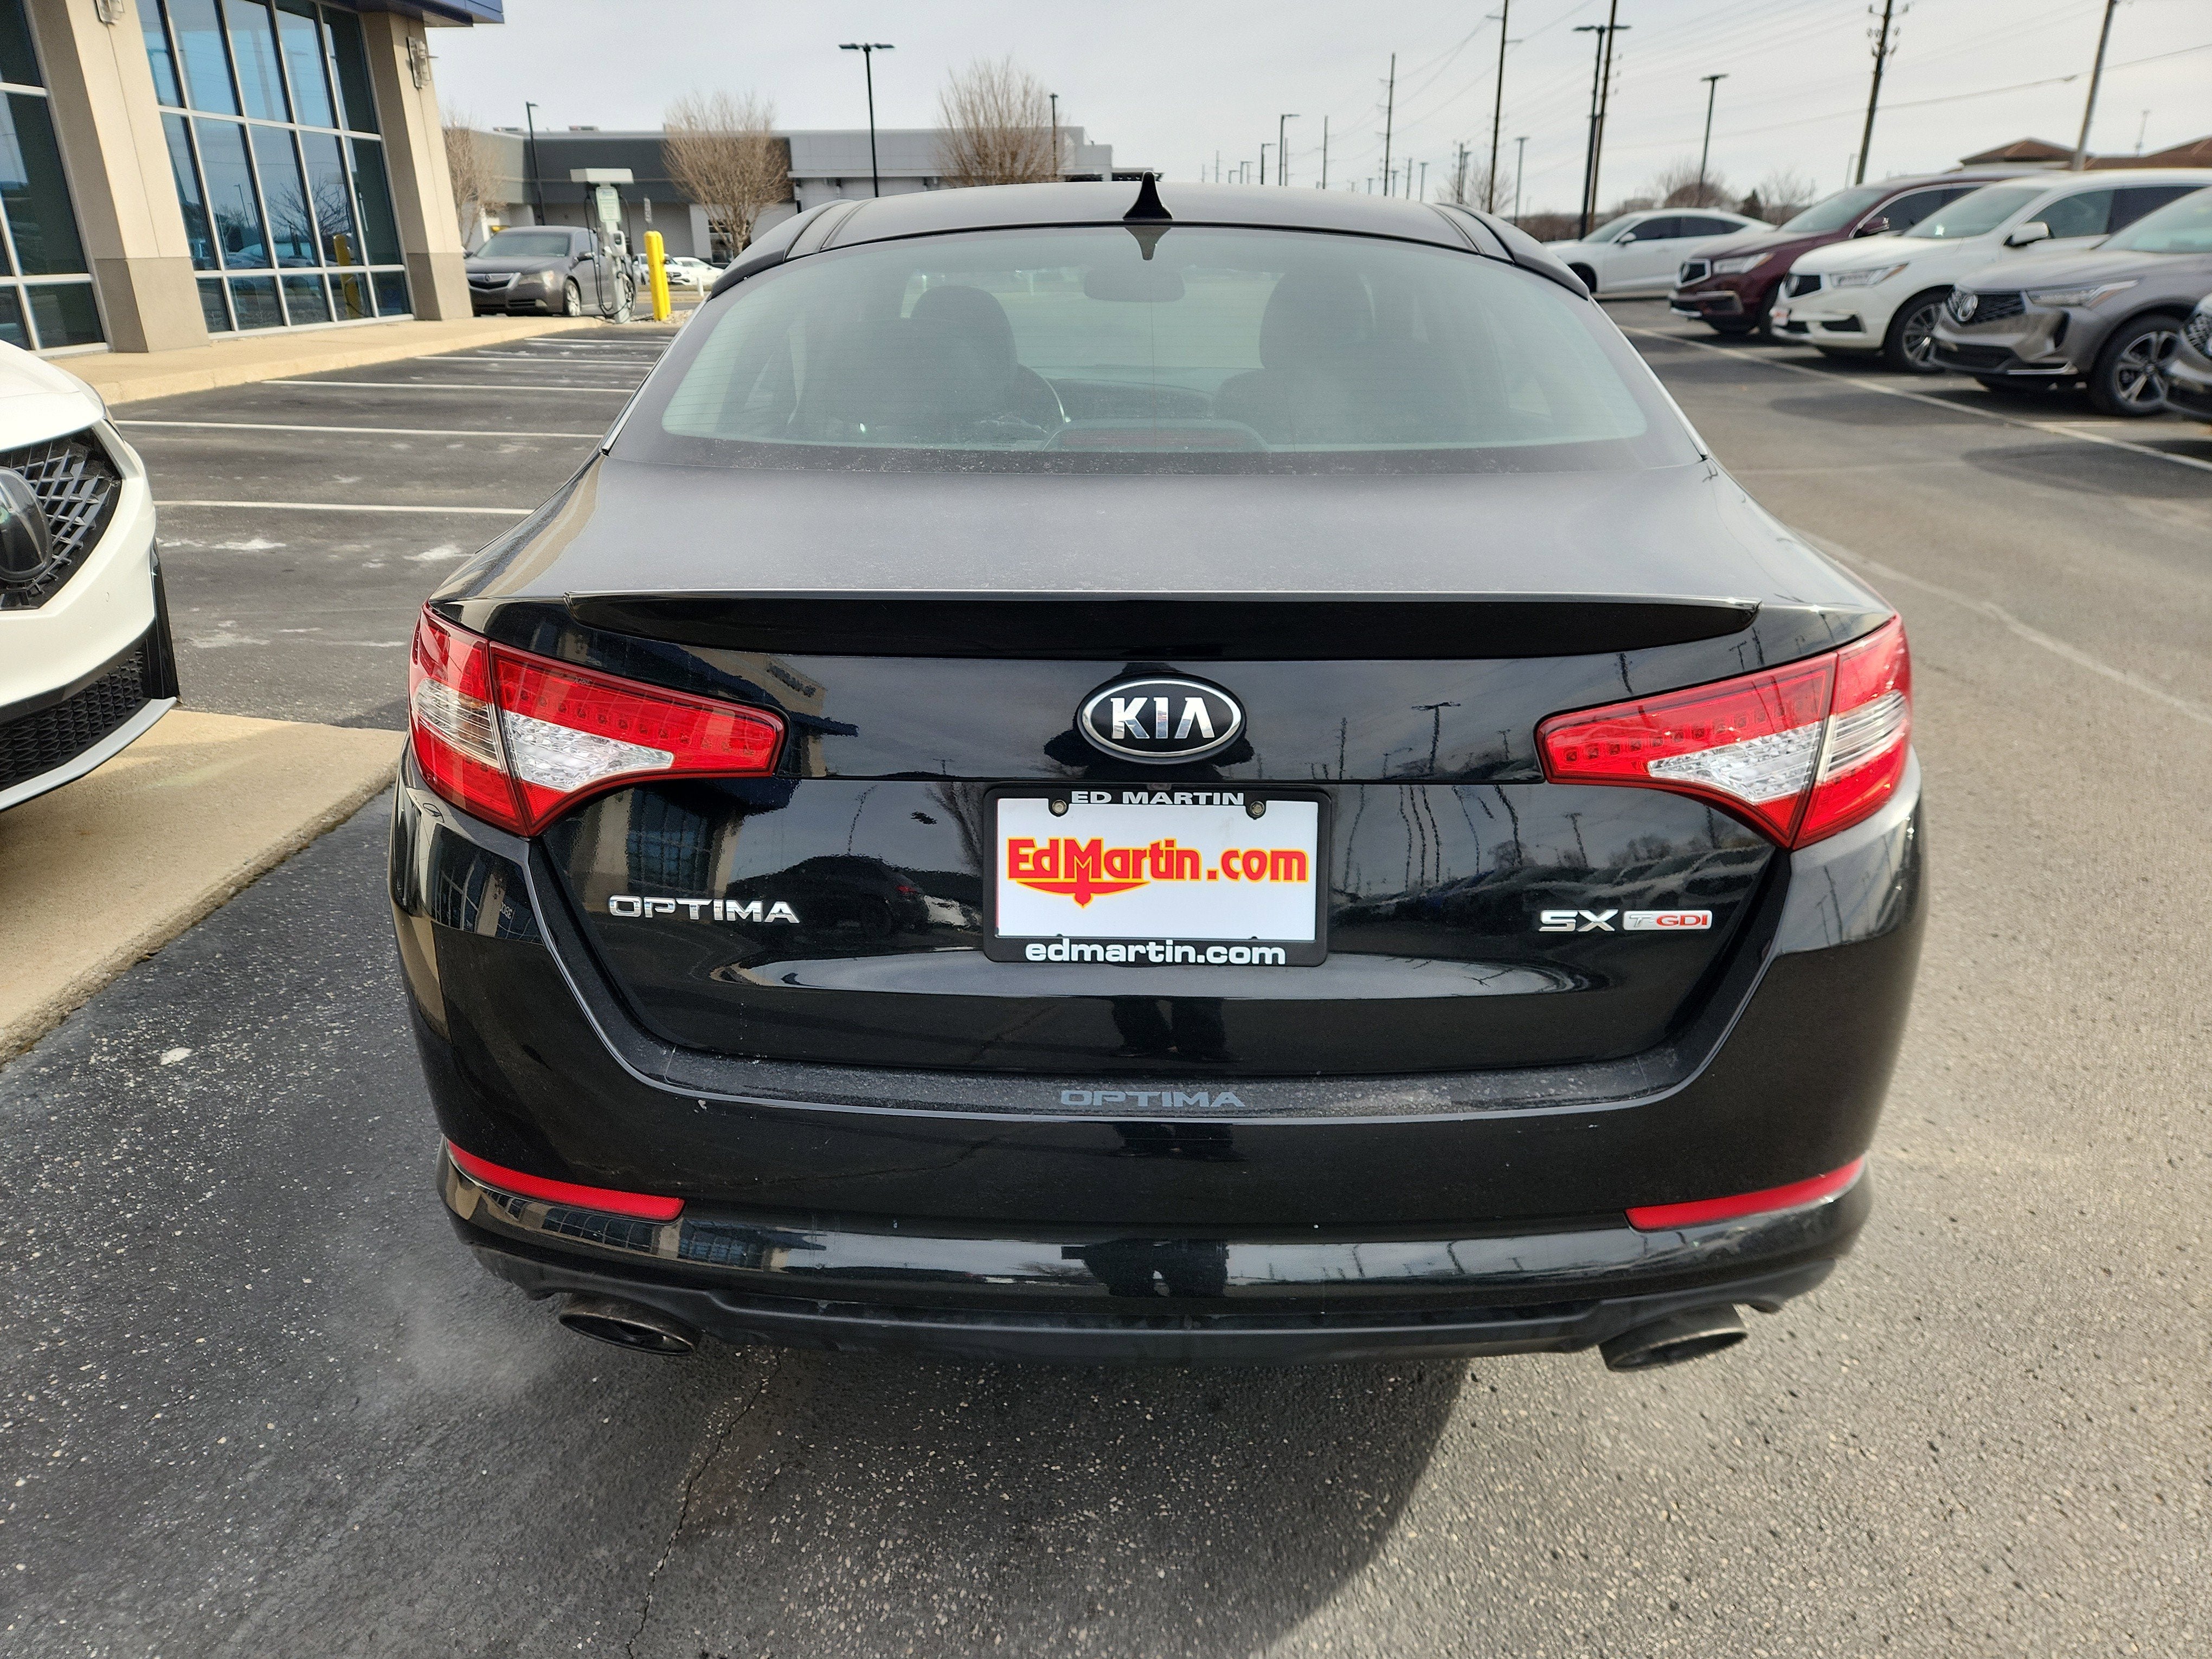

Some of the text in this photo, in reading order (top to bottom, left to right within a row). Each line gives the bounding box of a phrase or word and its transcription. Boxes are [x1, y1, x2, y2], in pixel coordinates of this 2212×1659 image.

[1110, 697, 1215, 739] KIA
[1071, 791, 1244, 806] ED MARTIN
[609, 895, 800, 923] OPTIMA
[1539, 909, 1708, 931] SX T-GDI
[1025, 938, 1286, 964] edmartin.com
[1061, 1090, 1246, 1107] OPTIMA
